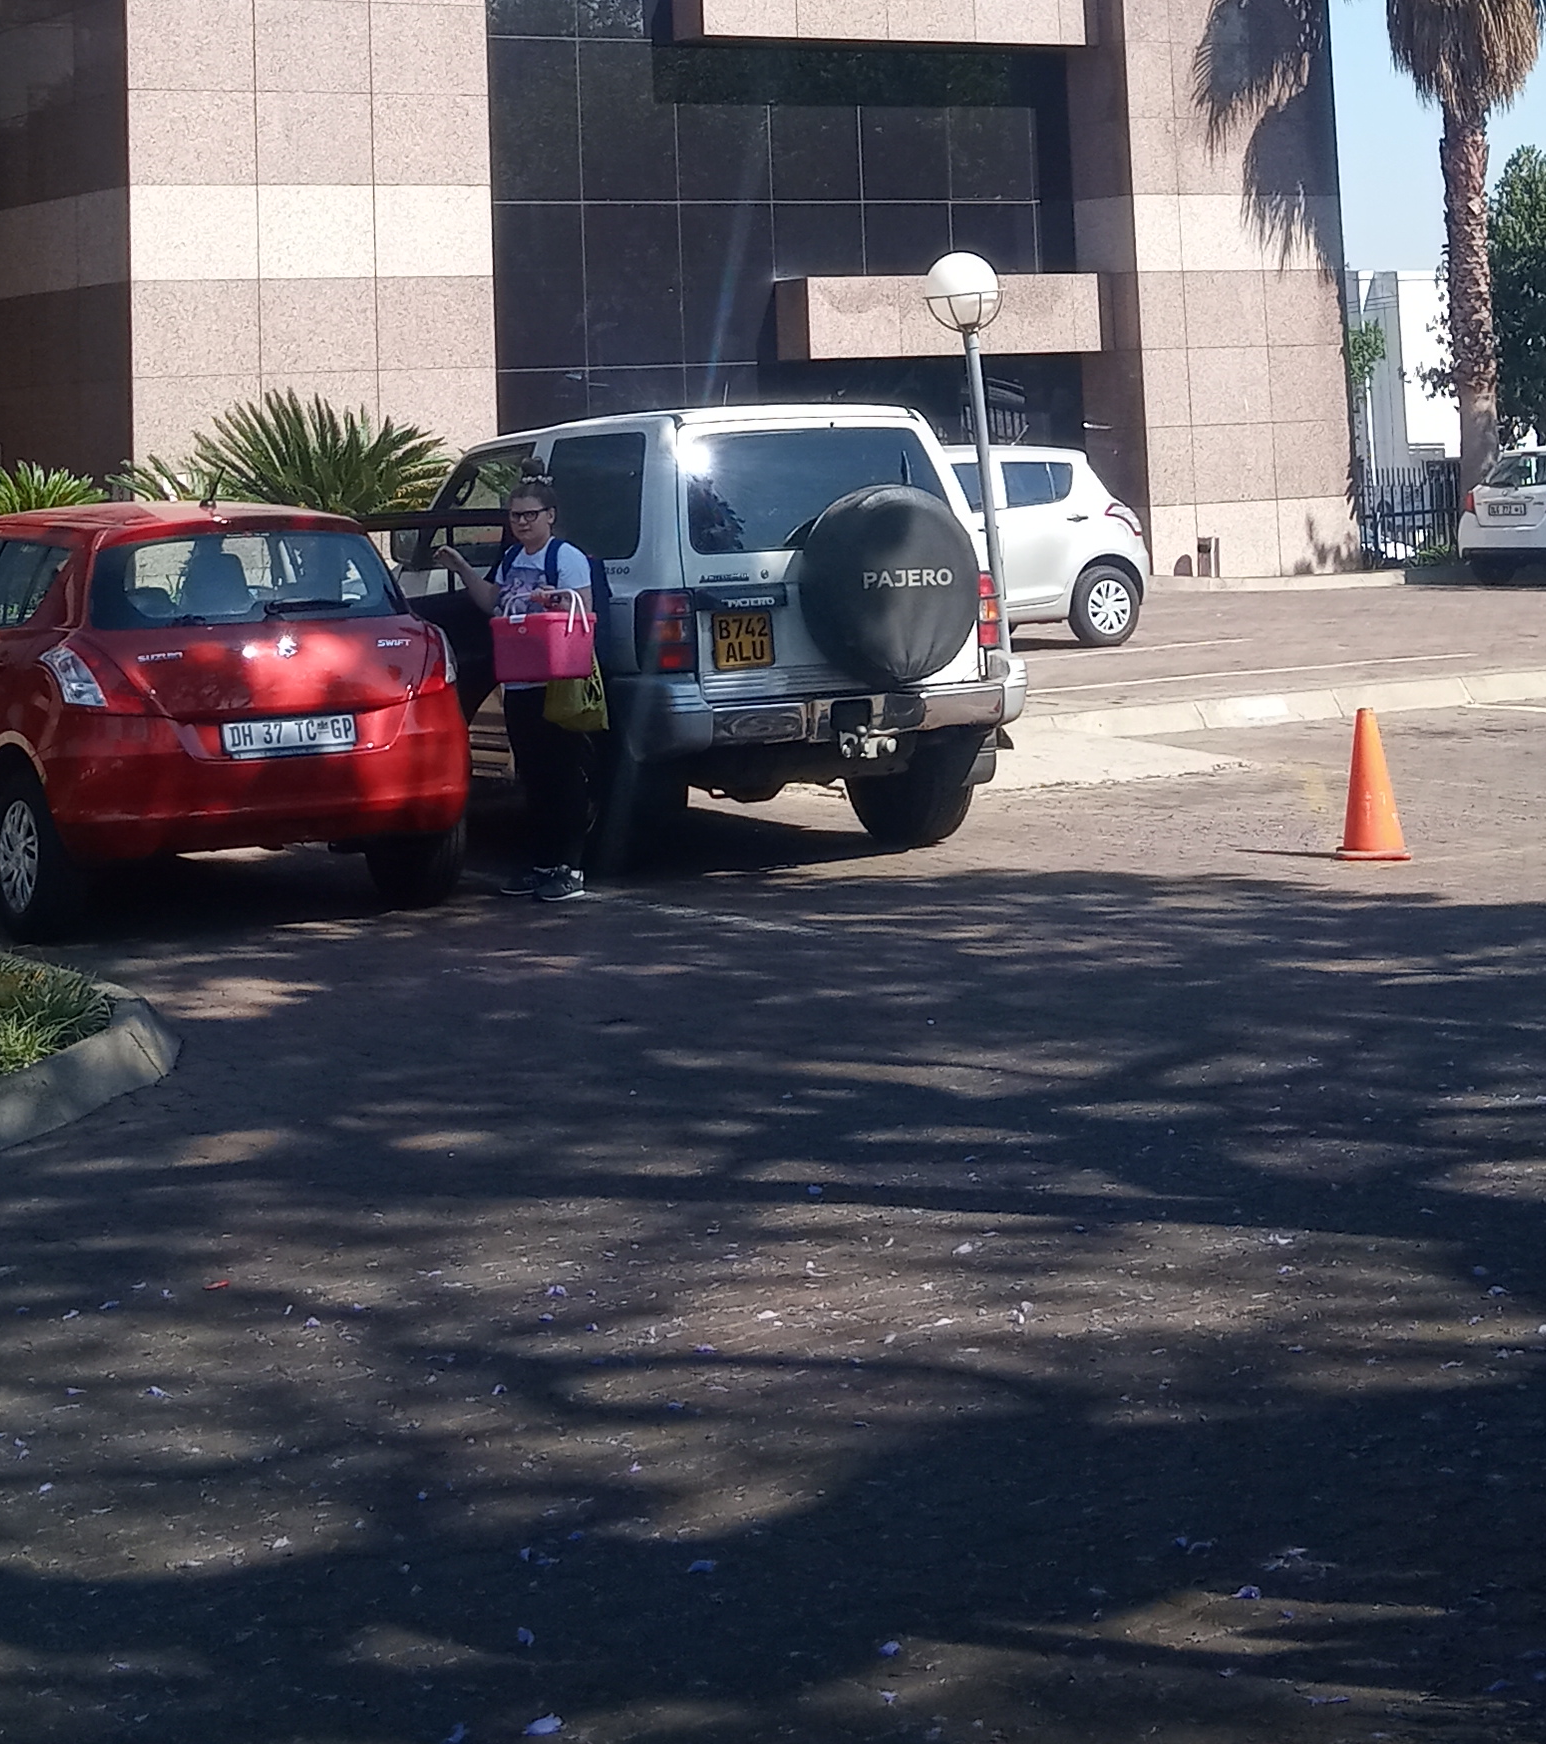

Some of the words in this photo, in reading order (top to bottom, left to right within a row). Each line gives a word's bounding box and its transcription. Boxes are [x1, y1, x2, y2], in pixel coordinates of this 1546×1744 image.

[862, 567, 954, 590] PAJERO
[718, 616, 769, 641] B742
[376, 638, 413, 648] SWIFT
[725, 639, 766, 664] ALU
[228, 724, 254, 747] DH
[261, 722, 283, 745] 37
[294, 719, 317, 743] TC
[329, 717, 353, 739] GP
